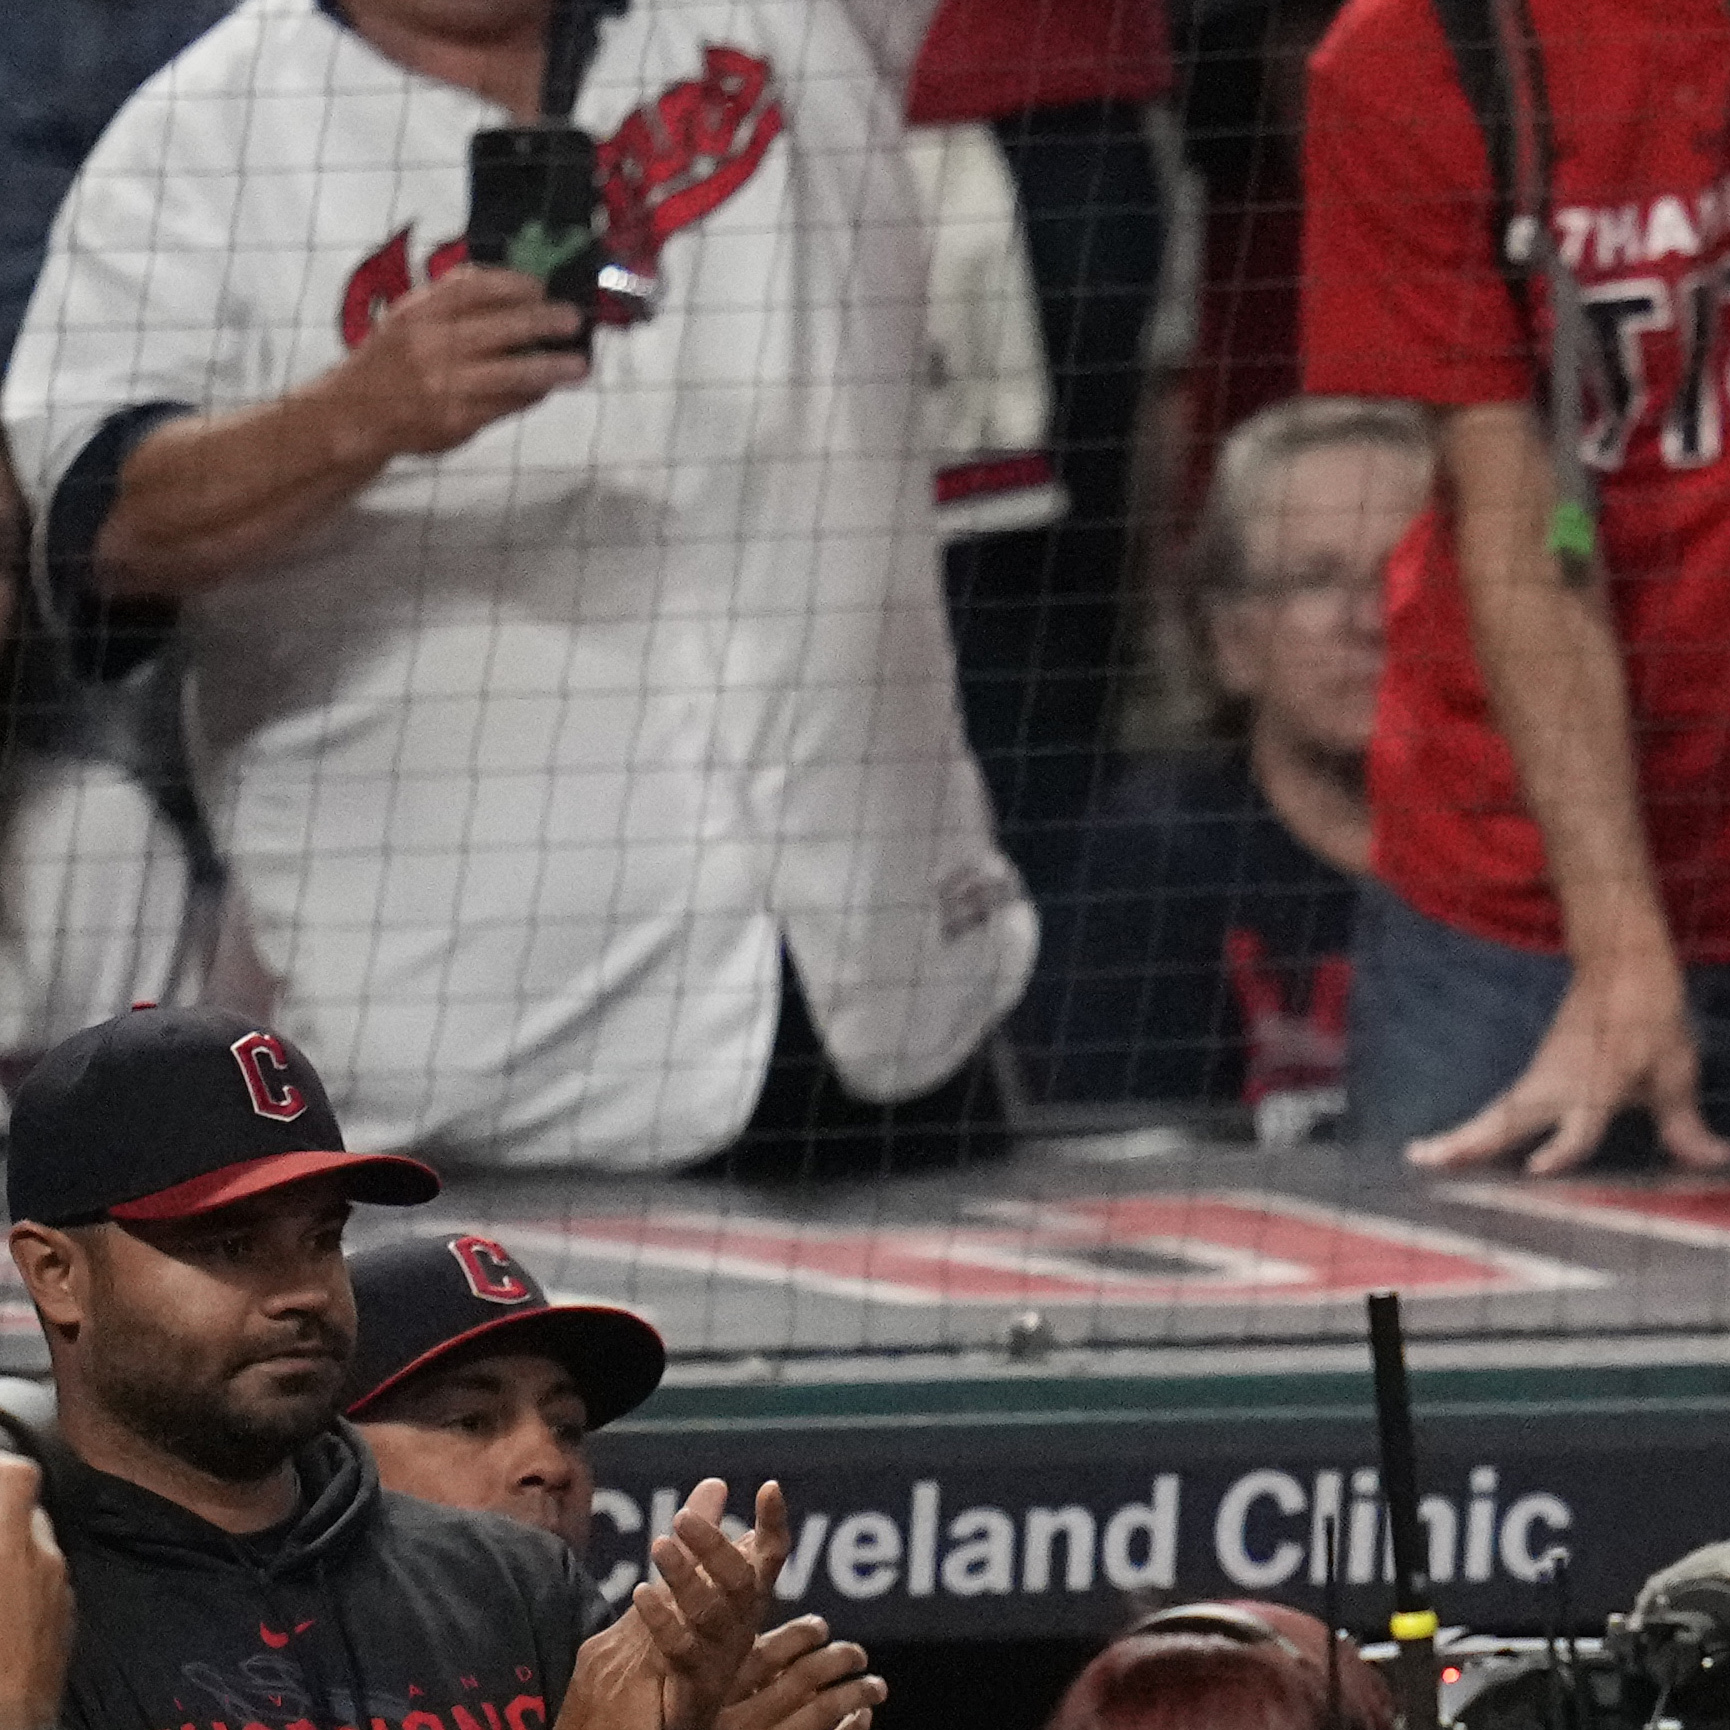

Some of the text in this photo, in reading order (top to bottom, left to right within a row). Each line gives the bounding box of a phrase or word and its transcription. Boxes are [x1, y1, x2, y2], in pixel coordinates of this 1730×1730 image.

[230, 1030, 308, 1123] C
[447, 1233, 532, 1305] C
[590, 1463, 1572, 1602] Clveland Clinic
